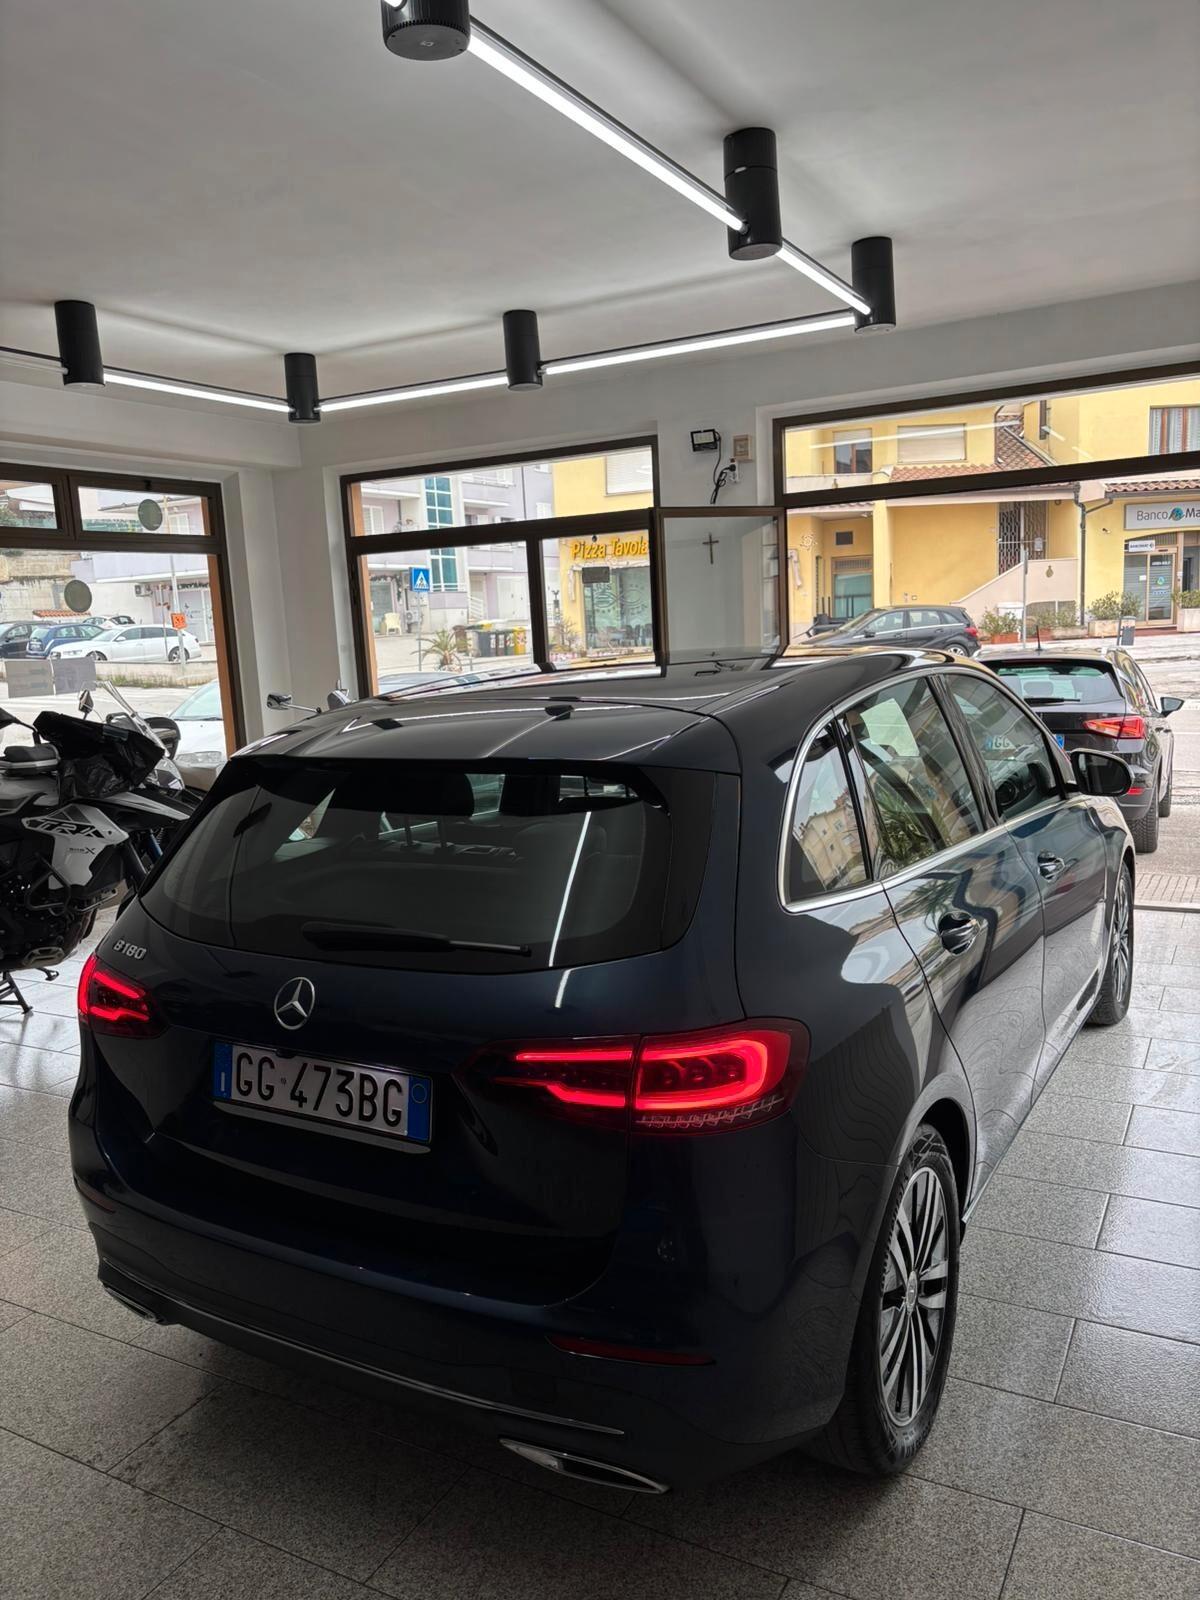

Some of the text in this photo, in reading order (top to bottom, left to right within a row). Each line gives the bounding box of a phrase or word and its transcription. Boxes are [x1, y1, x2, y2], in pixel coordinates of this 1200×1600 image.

[1136, 510, 1168, 521] Banco
[571, 536, 649, 559] Pizza Tavola
[113, 939, 147, 959] B180
[236, 1052, 275, 1101] GG
[289, 1062, 403, 1128] 473BG
